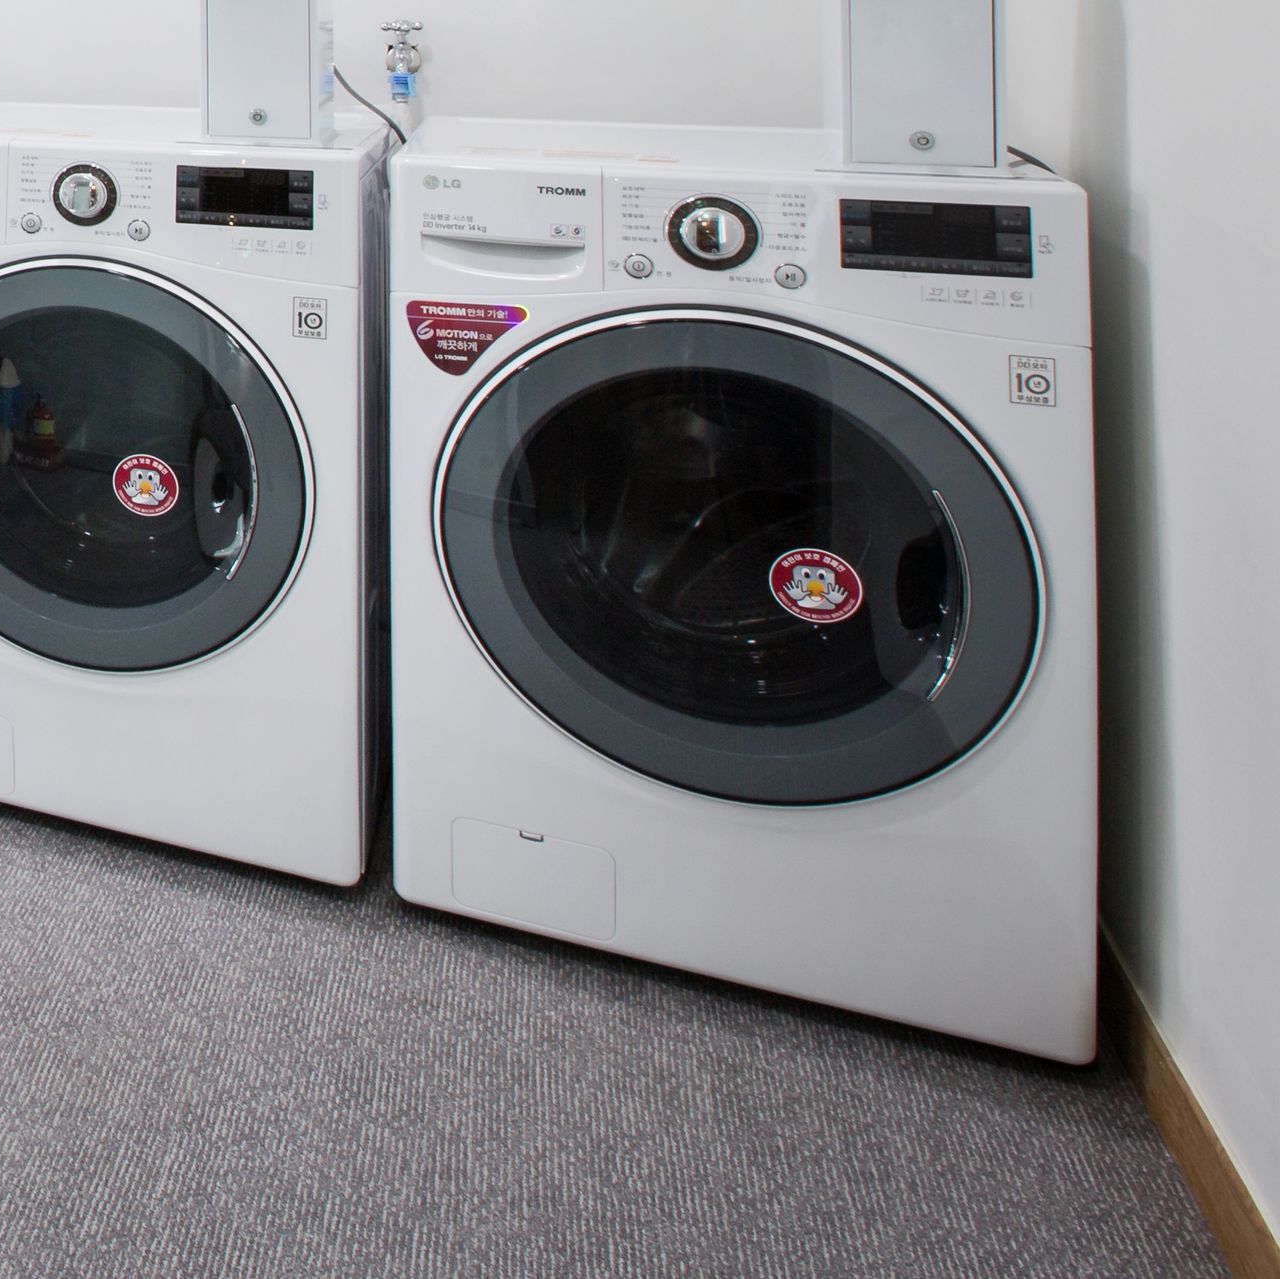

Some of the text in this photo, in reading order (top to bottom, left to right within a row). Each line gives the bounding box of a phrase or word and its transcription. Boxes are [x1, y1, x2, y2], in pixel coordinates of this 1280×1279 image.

[443, 179, 462, 189] LG
[537, 186, 587, 196] TROMM
[435, 222, 466, 231] Inverter
[437, 340, 478, 352] 깨끗하게
